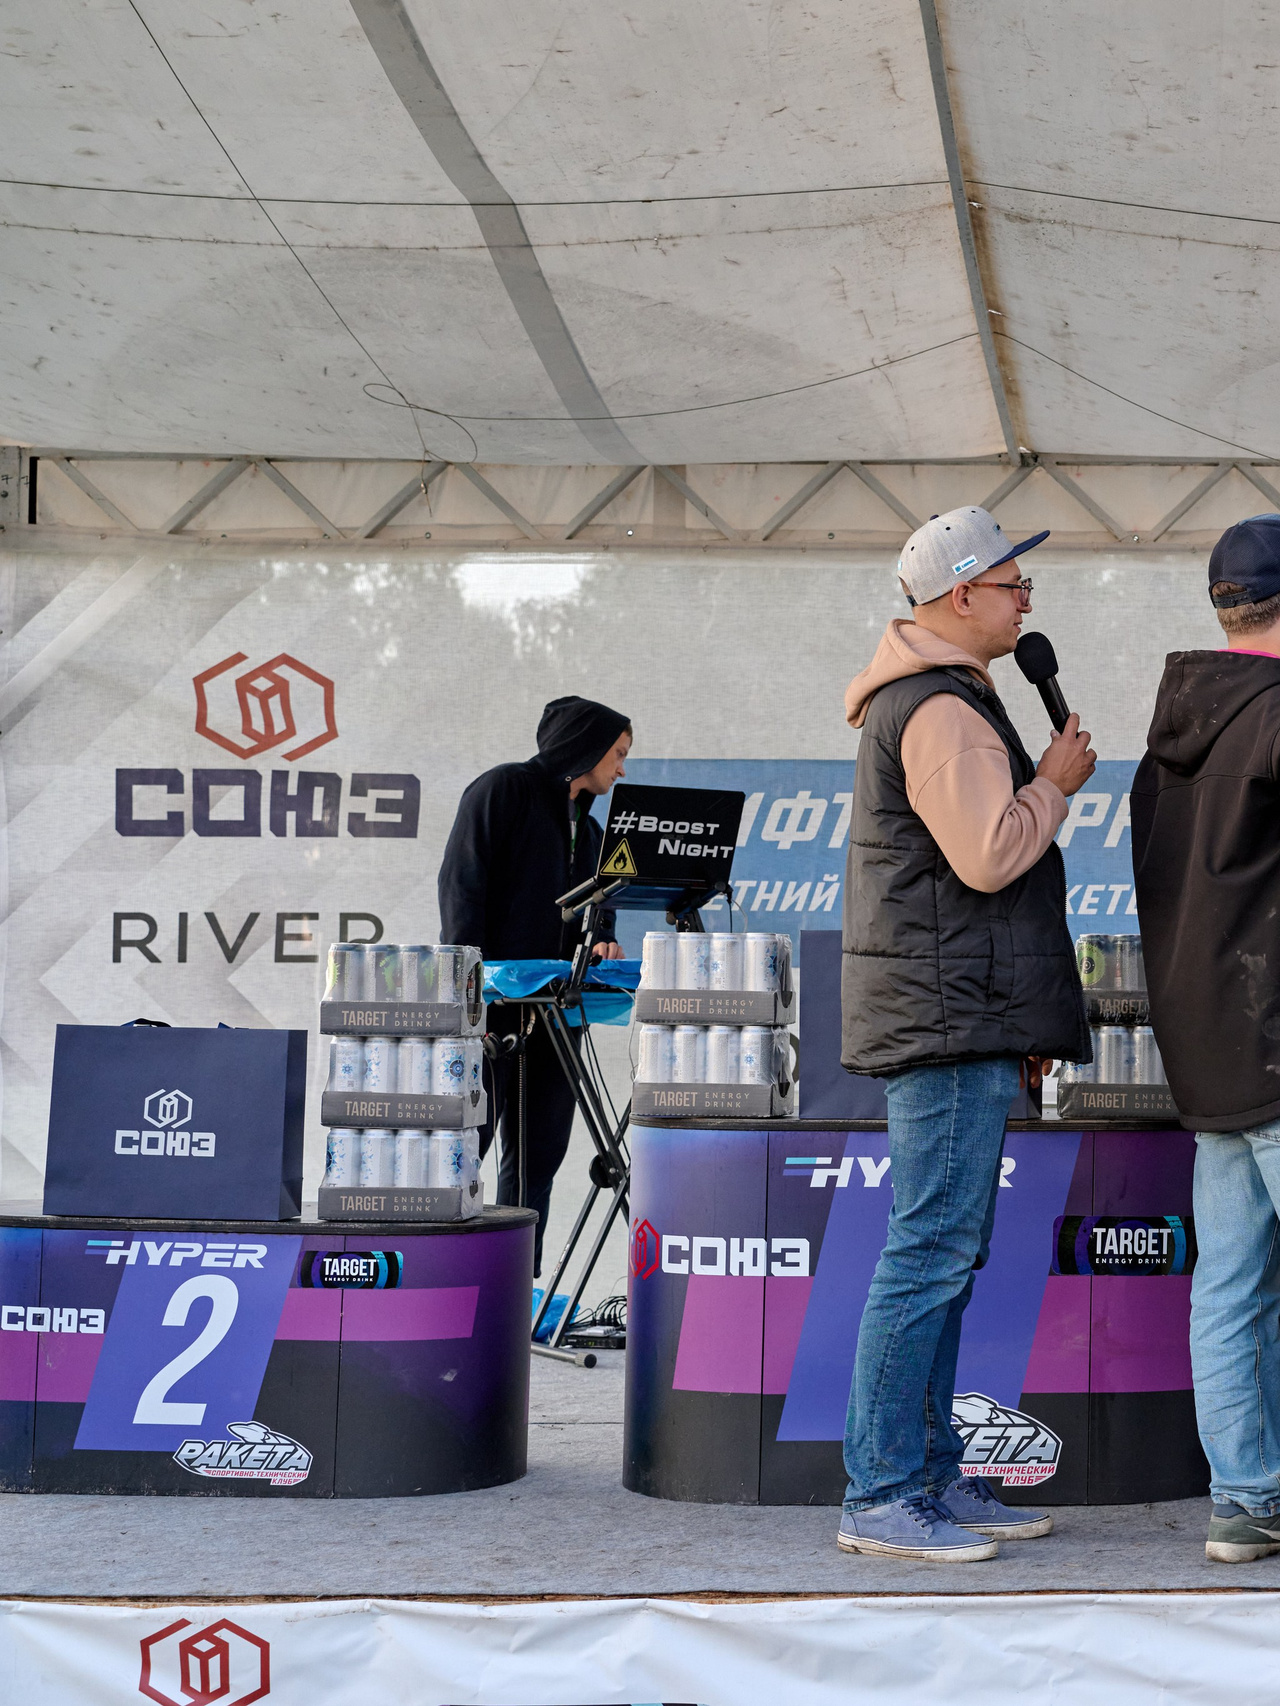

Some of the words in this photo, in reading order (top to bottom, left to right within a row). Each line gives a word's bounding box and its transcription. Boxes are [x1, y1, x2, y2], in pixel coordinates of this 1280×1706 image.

[115, 767, 421, 838] СОЮЗ
[112, 911, 385, 964] RIVER
[657, 997, 703, 1014] TARGET
[709, 999, 754, 1007] ENERGY
[342, 1010, 387, 1027] TARGET
[394, 1011, 441, 1019] ENERGY
[394, 1020, 431, 1028] DRINK
[652, 1091, 698, 1107] TARGET
[705, 1092, 750, 1100] ENERGY
[1081, 1092, 1128, 1109] TARGET
[1134, 1093, 1172, 1101] ENERG
[1134, 1102, 1172, 1110] DRINK
[344, 1100, 391, 1118] TARGET
[397, 1103, 443, 1112] ENERGY
[397, 1111, 435, 1120] DRINK
[114, 1129, 216, 1157] СОЮЗ
[340, 1195, 387, 1212] TARGET
[394, 1196, 439, 1204] ENERGY
[1092, 1227, 1172, 1255] TARGET
[104, 1240, 268, 1268] HYPER
[661, 1233, 811, 1277] СОЮЗ
[1095, 1257, 1133, 1265] ENERGY
[1138, 1257, 1168, 1265] DRINK
[323, 1257, 377, 1277] TARGET
[1, 1305, 106, 1334] СОЮЗ
[132, 1274, 239, 1426] 2
[175, 1440, 312, 1470] РАКЕТА
[211, 1470, 308, 1478] СПОРТИВНО-ТЕХНИЧЕСКИЙ
[960, 1464, 1056, 1475] НО-ТЕХНИЧЕСКИЙ
[1004, 1476, 1034, 1485] КЛУБ
